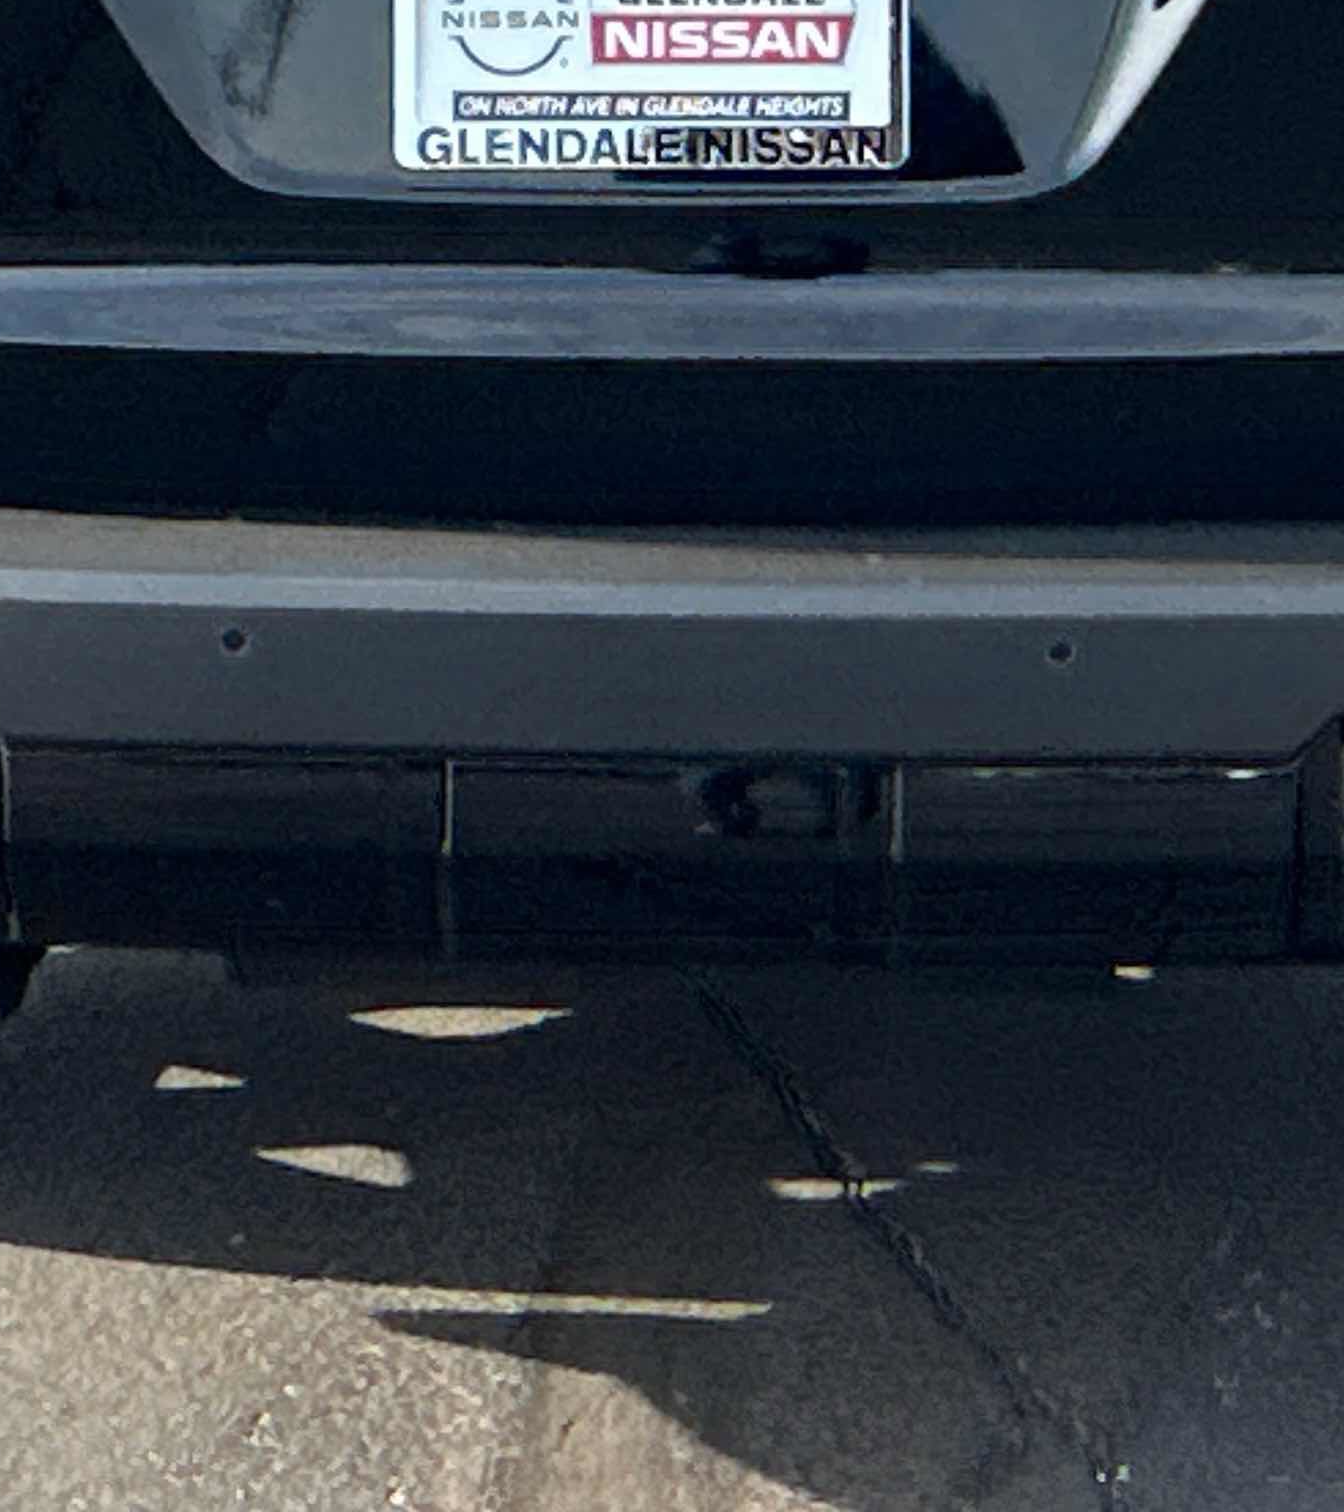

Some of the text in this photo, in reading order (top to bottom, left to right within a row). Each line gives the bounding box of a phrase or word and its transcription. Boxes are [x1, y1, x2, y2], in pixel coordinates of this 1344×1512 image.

[442, 9, 579, 29] NISSAN
[603, 20, 840, 60] NISSAN
[459, 96, 844, 116] ON NORTH AVE IN GLENDALE HEIGHTS
[417, 127, 888, 165] GLENDALE NISSAN
